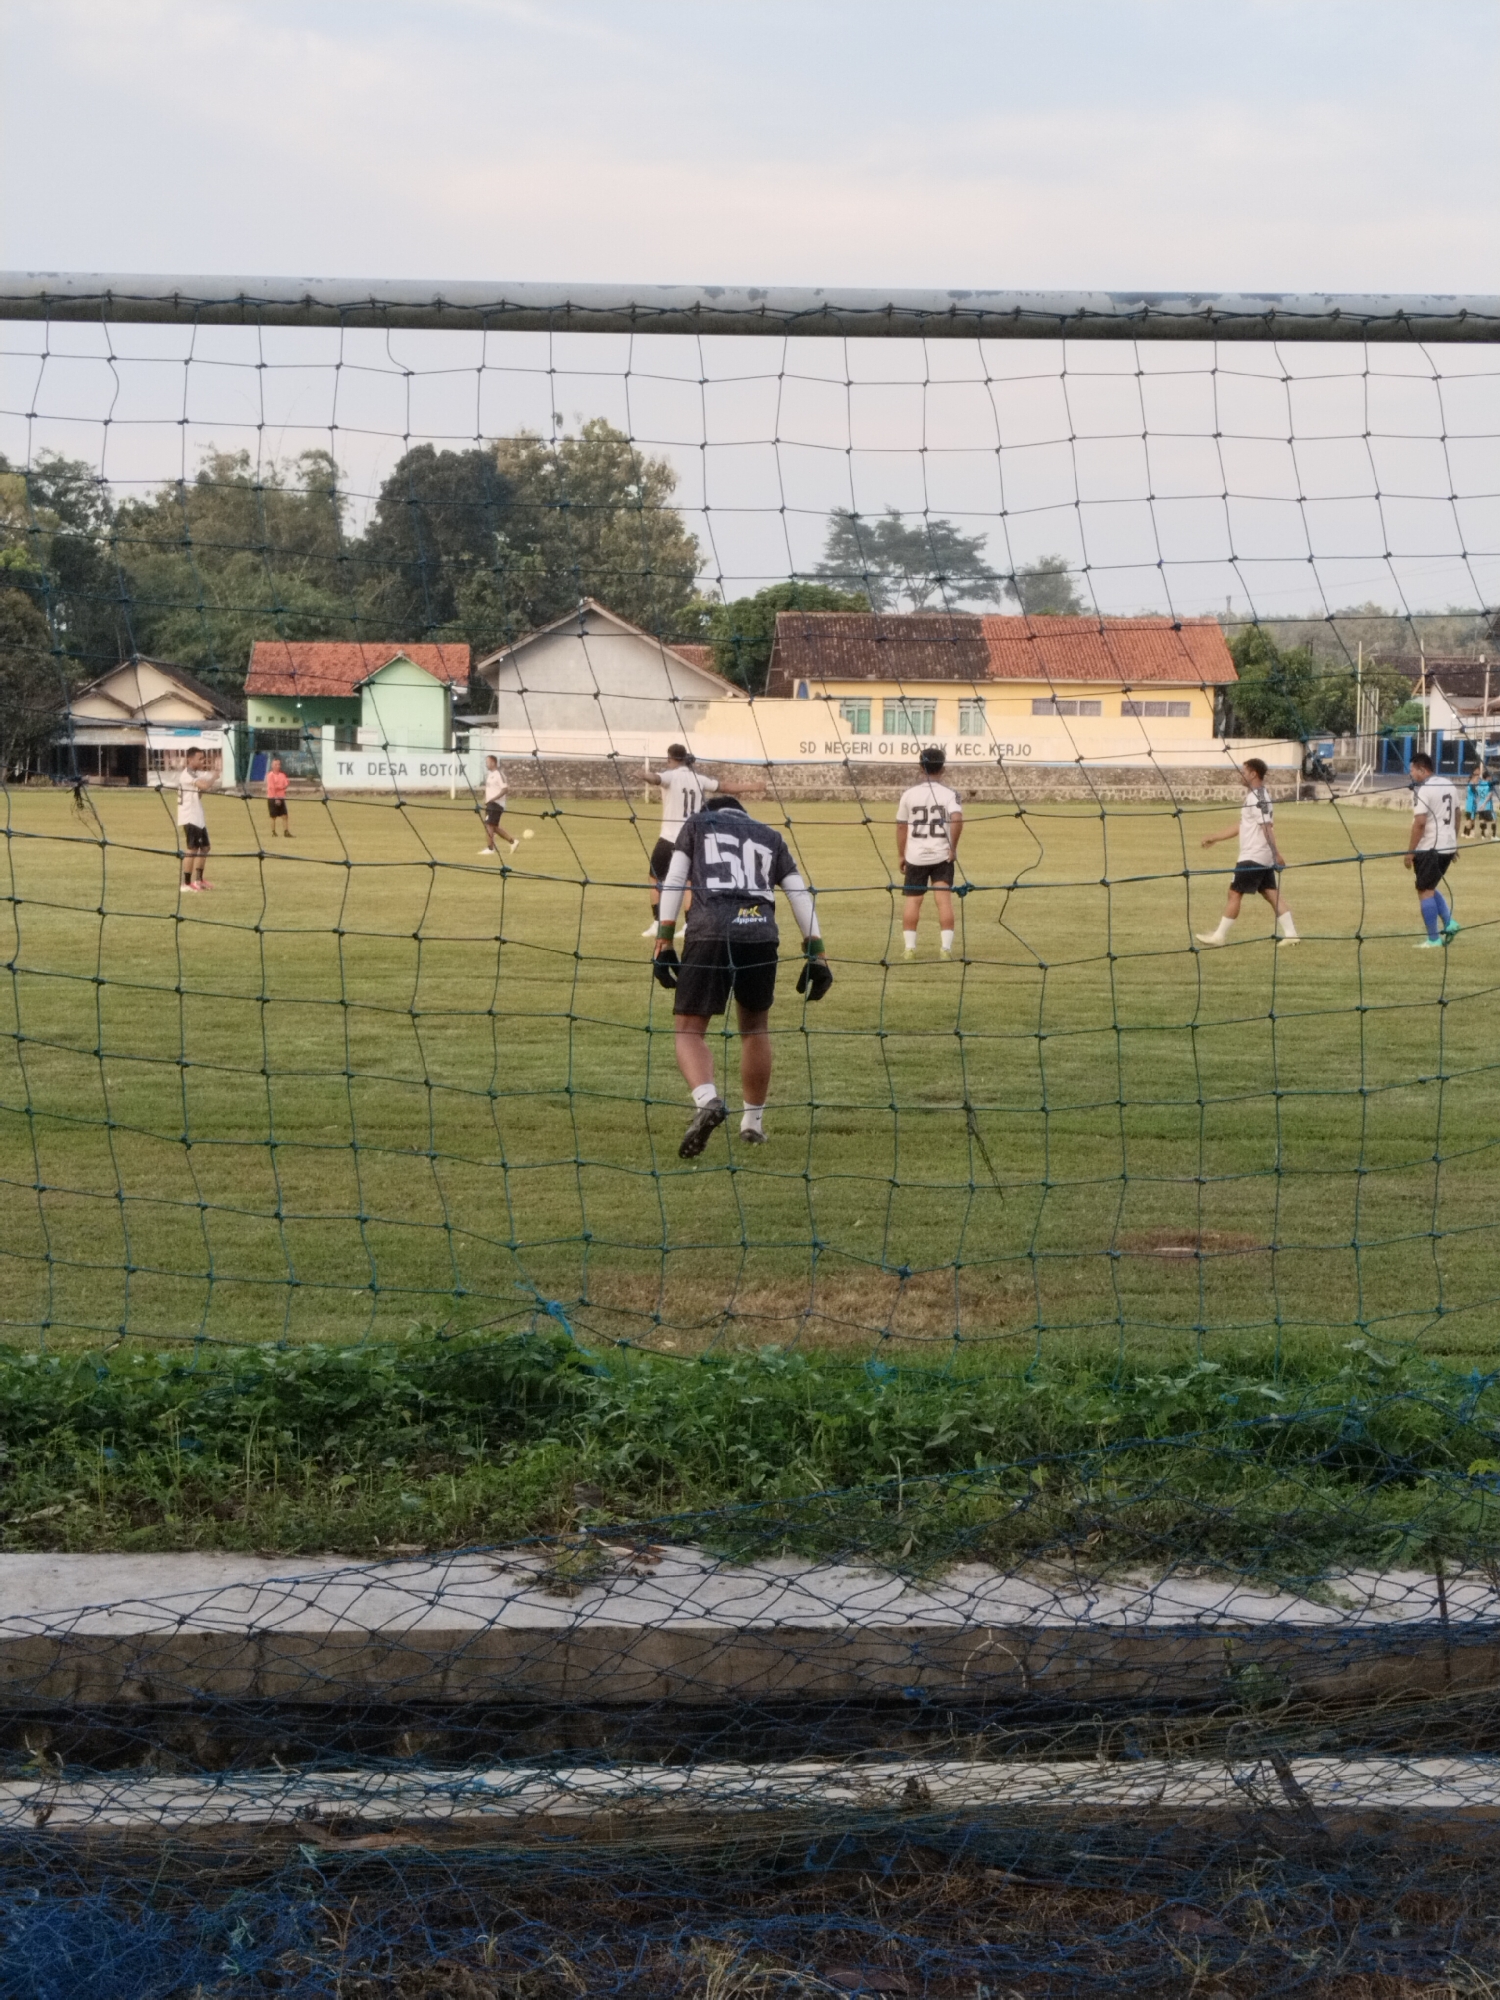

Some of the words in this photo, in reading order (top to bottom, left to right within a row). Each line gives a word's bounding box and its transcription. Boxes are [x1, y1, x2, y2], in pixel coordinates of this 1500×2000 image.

[799, 741, 816, 754] SD
[824, 741, 872, 755] NEGERI
[955, 743, 985, 756] KEC.
[989, 744, 1031, 756] KERJO
[337, 762, 354, 775] TK
[368, 762, 408, 776] DESA
[420, 763, 467, 776] BOTOK
[682, 788, 696, 818] 11
[1441, 793, 1453, 825] 3
[911, 805, 946, 838] 22
[703, 833, 774, 902] 50
